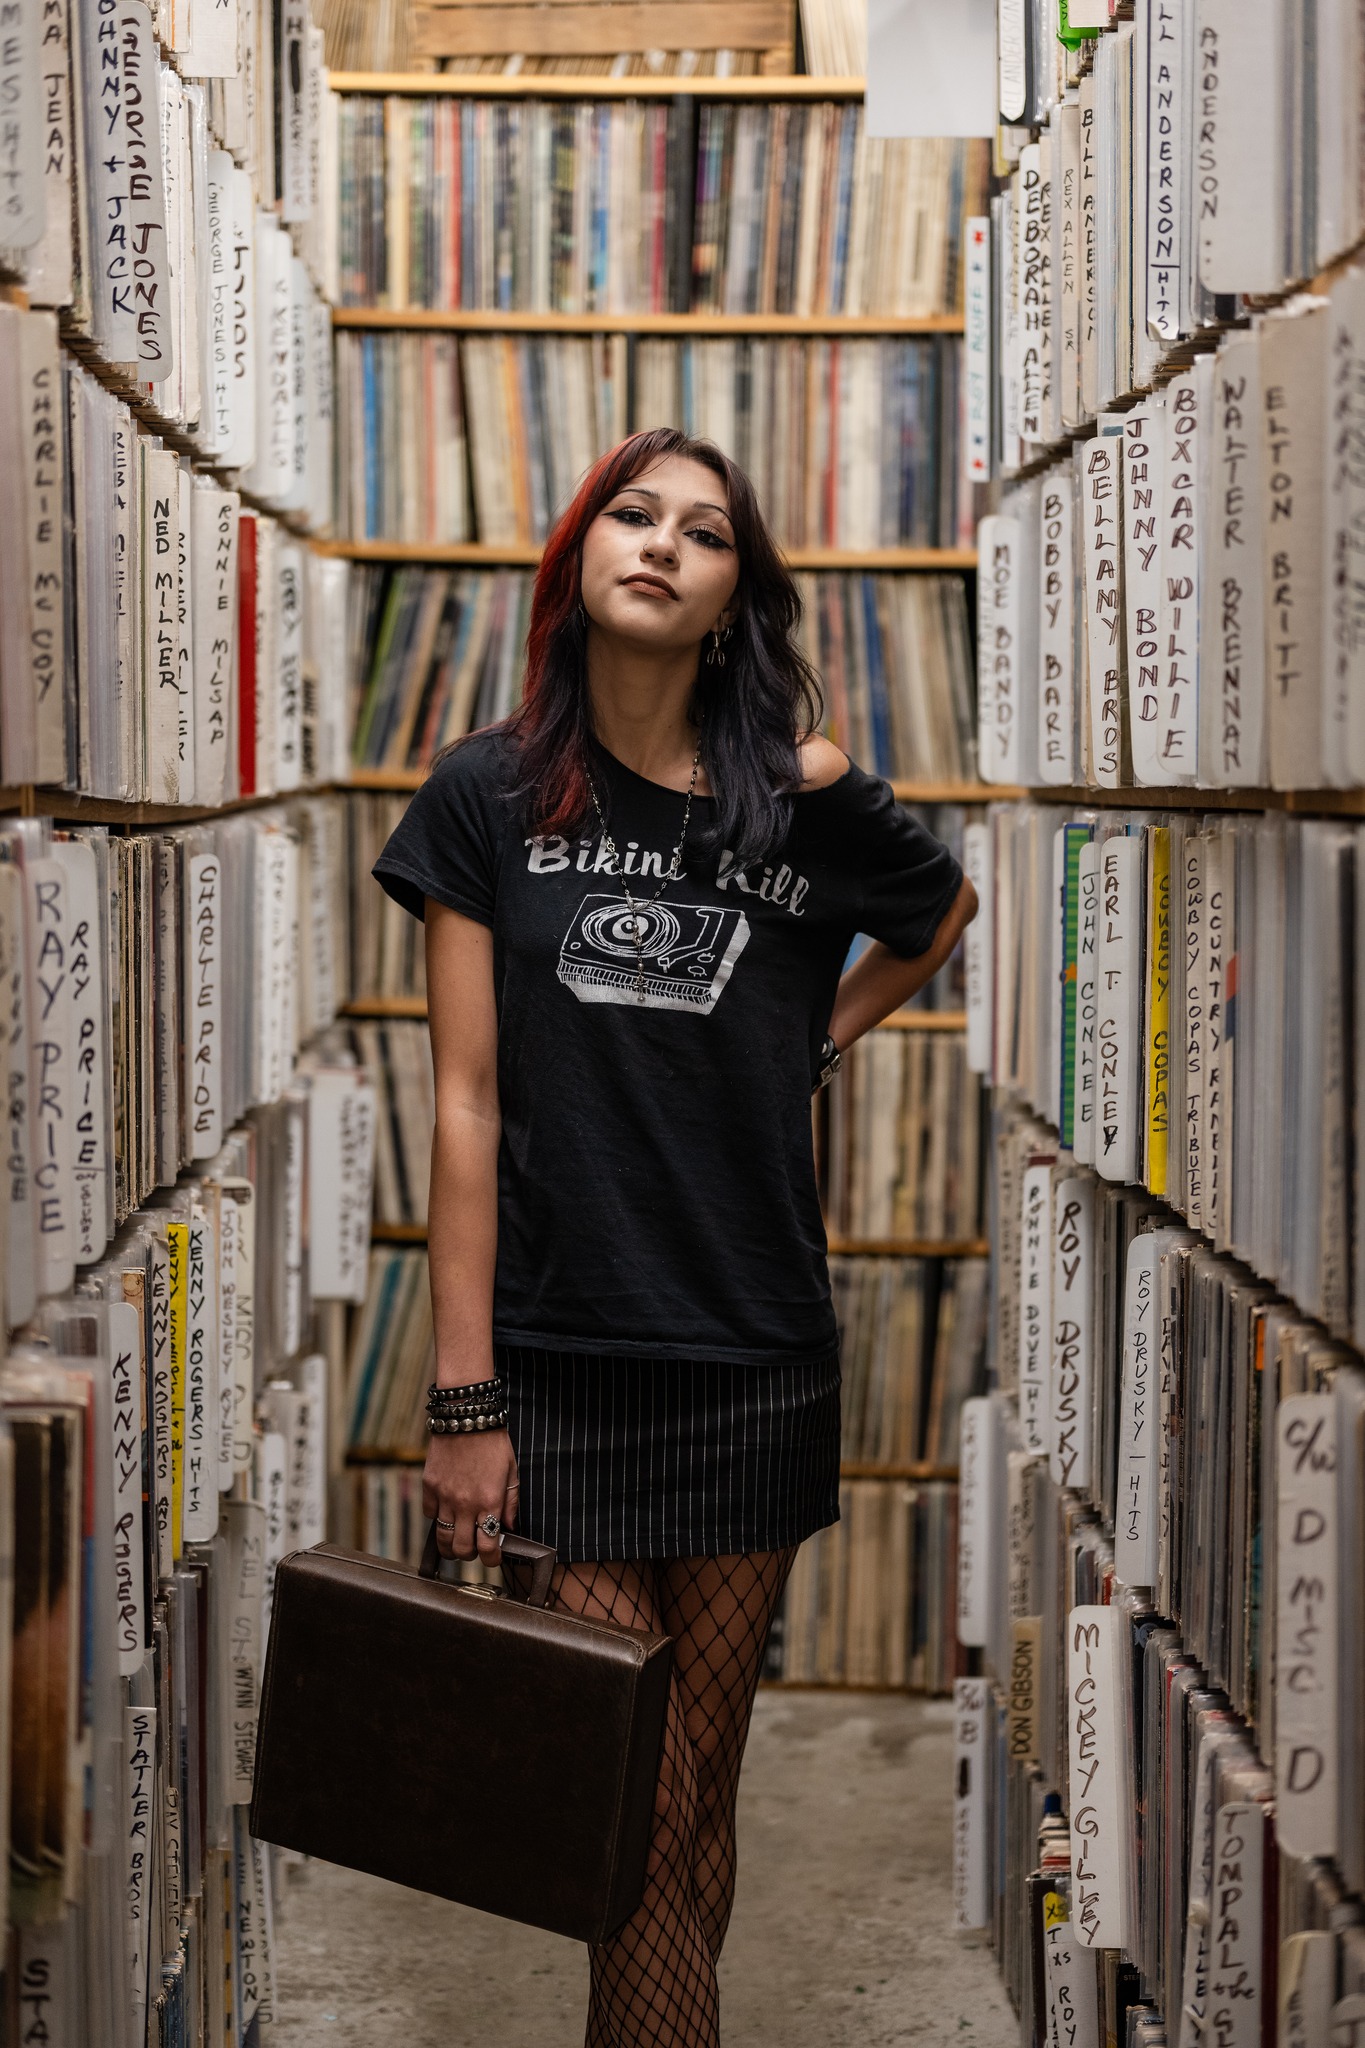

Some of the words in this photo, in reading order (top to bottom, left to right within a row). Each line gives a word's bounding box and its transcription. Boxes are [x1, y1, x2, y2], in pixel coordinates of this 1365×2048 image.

[97, 0, 121, 135] OHNNY
[121, 17, 152, 201] GEORGE
[44, 74, 65, 174] JEAN
[1081, 108, 1094, 181] BILL
[1154, 64, 1174, 260] ANDERSON
[1198, 26, 1220, 220] ANDERSON
[208, 182, 224, 274] GEORGE
[1040, 181, 1052, 242] REX
[1063, 168, 1075, 211] REX
[106, 196, 135, 315] JACK
[132, 222, 162, 361] JONES
[1023, 170, 1040, 330] DEBORAH
[1041, 254, 1052, 348] ALLEN
[1063, 221, 1075, 295] ALLEN
[1154, 272, 1170, 331] HITS
[213, 284, 228, 362] JONES
[1065, 328, 1076, 352] SR
[215, 382, 230, 436] HITS
[1023, 347, 1040, 434] ALLEN
[32, 367, 53, 544] CHARLIE
[1126, 417, 1157, 572] JOHNNY
[1170, 388, 1198, 550] BOXCAR
[1222, 377, 1246, 549] WALTER
[1266, 386, 1292, 522] ELTON
[154, 498, 170, 554] NED
[217, 504, 233, 611] RONNIE
[994, 544, 1010, 609] MOE
[1045, 494, 1063, 628] BOBBY
[1088, 449, 1118, 646] BELLAMY
[155, 573, 179, 690] MILLER
[1136, 608, 1158, 722] BOND
[1162, 576, 1193, 759] WILLIE
[1222, 577, 1242, 773] BRENNAN
[1272, 552, 1302, 697] BRITT
[210, 638, 228, 745] MILSAP
[995, 627, 1012, 758] BANDY
[1046, 654, 1064, 762] BARE
[1098, 668, 1119, 773] BROS
[525, 834, 687, 882] Bikini
[715, 848, 809, 917] Kill
[1082, 872, 1099, 954] JOHN
[1104, 854, 1123, 944] EARL
[1186, 856, 1203, 972] COWBOY
[36, 881, 65, 1020] RAY
[70, 921, 90, 1000] RAY
[197, 866, 218, 1008] CHARLIE
[1158, 875, 1169, 1003] COWBOY
[194, 1021, 215, 1133] PRIDE
[1081, 981, 1097, 1122] CONLEE
[1153, 1030, 1169, 1133] COPAS
[1186, 986, 1202, 1073] COPAS
[33, 1042, 64, 1233] PRICE
[77, 1018, 97, 1163] PRICE
[1186, 1095, 1202, 1216] TRIBUTES
[189, 1230, 205, 1320] KENNY
[222, 1209, 235, 1269] JOHN
[1026, 1185, 1040, 1289] RONNIE
[1057, 1200, 1082, 1292] ROY
[153, 1263, 168, 1359] KENNY
[221, 1283, 235, 1375] WESLEY
[1026, 1304, 1041, 1374] DOVE
[1136, 1270, 1152, 1322] ROY
[113, 1352, 138, 1494] KENNY
[154, 1371, 169, 1479] ROGERS
[190, 1329, 204, 1440] ROGERS
[219, 1389, 234, 1463] RYLES
[1026, 1386, 1042, 1447] HITS
[1055, 1319, 1081, 1486] DRUSKY
[1132, 1332, 1148, 1441] DRUSKY
[189, 1459, 200, 1513] HITS
[1126, 1474, 1141, 1541] HITS
[1294, 1508, 1326, 1545] D
[115, 1512, 138, 1653] ROGERS
[1287, 1575, 1324, 1694] MISC
[235, 1665, 253, 1709] WYNN
[1012, 1640, 1032, 1712] GIBSON
[1073, 1623, 1100, 1798] MICKEY
[130, 1714, 151, 1838] STATLER
[234, 1720, 253, 1785] STEWART
[960, 1721, 978, 1745] B
[1011, 1717, 1032, 1755] DON
[1287, 1745, 1324, 1793] D
[128, 1853, 144, 1920] BROS
[1074, 1805, 1100, 1945] GILLEY
[1218, 1811, 1249, 1969] TOMPAL
[21, 1959, 51, 2044] STA
[1053, 1951, 1071, 1967] XS
[1058, 1985, 1077, 2046] ROY
